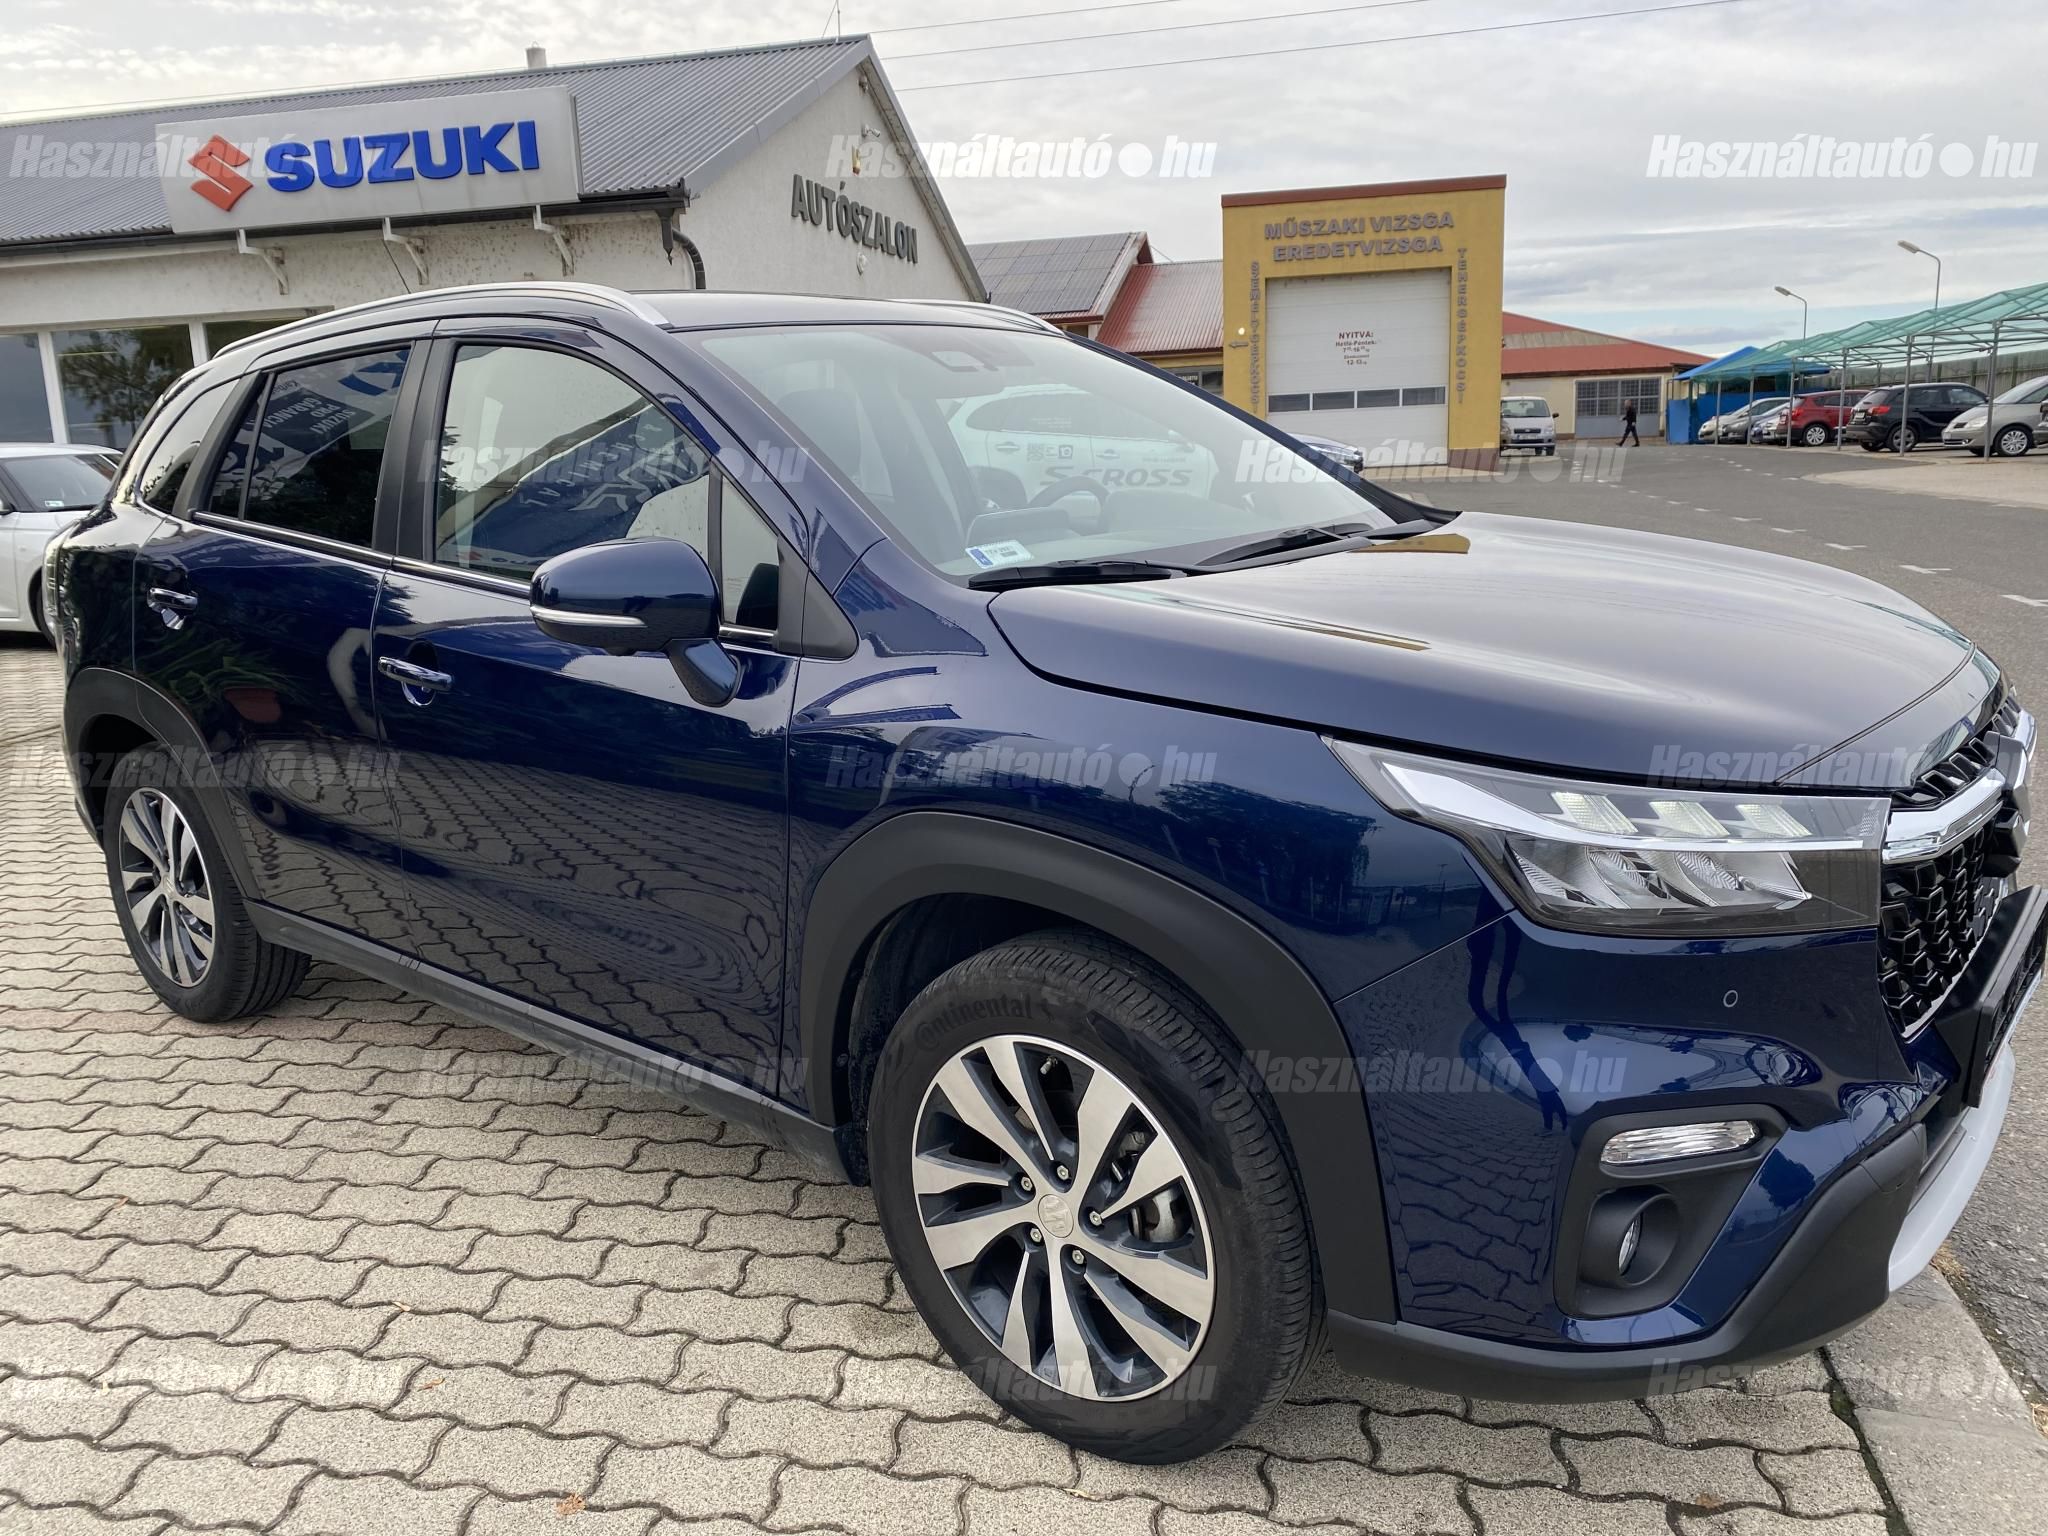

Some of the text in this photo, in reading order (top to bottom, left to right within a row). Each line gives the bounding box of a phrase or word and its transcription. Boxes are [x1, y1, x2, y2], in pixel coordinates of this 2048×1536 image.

[264, 119, 540, 193] SUZUKI
[790, 173, 919, 265] AUTÓSZALON
[1264, 211, 1455, 240] MŰSZAKI VIZSGA
[1273, 235, 1443, 262] EREDETVIZSGA
[1338, 330, 1374, 340] NYITVA:
[914, 992, 1033, 1051] Continental
